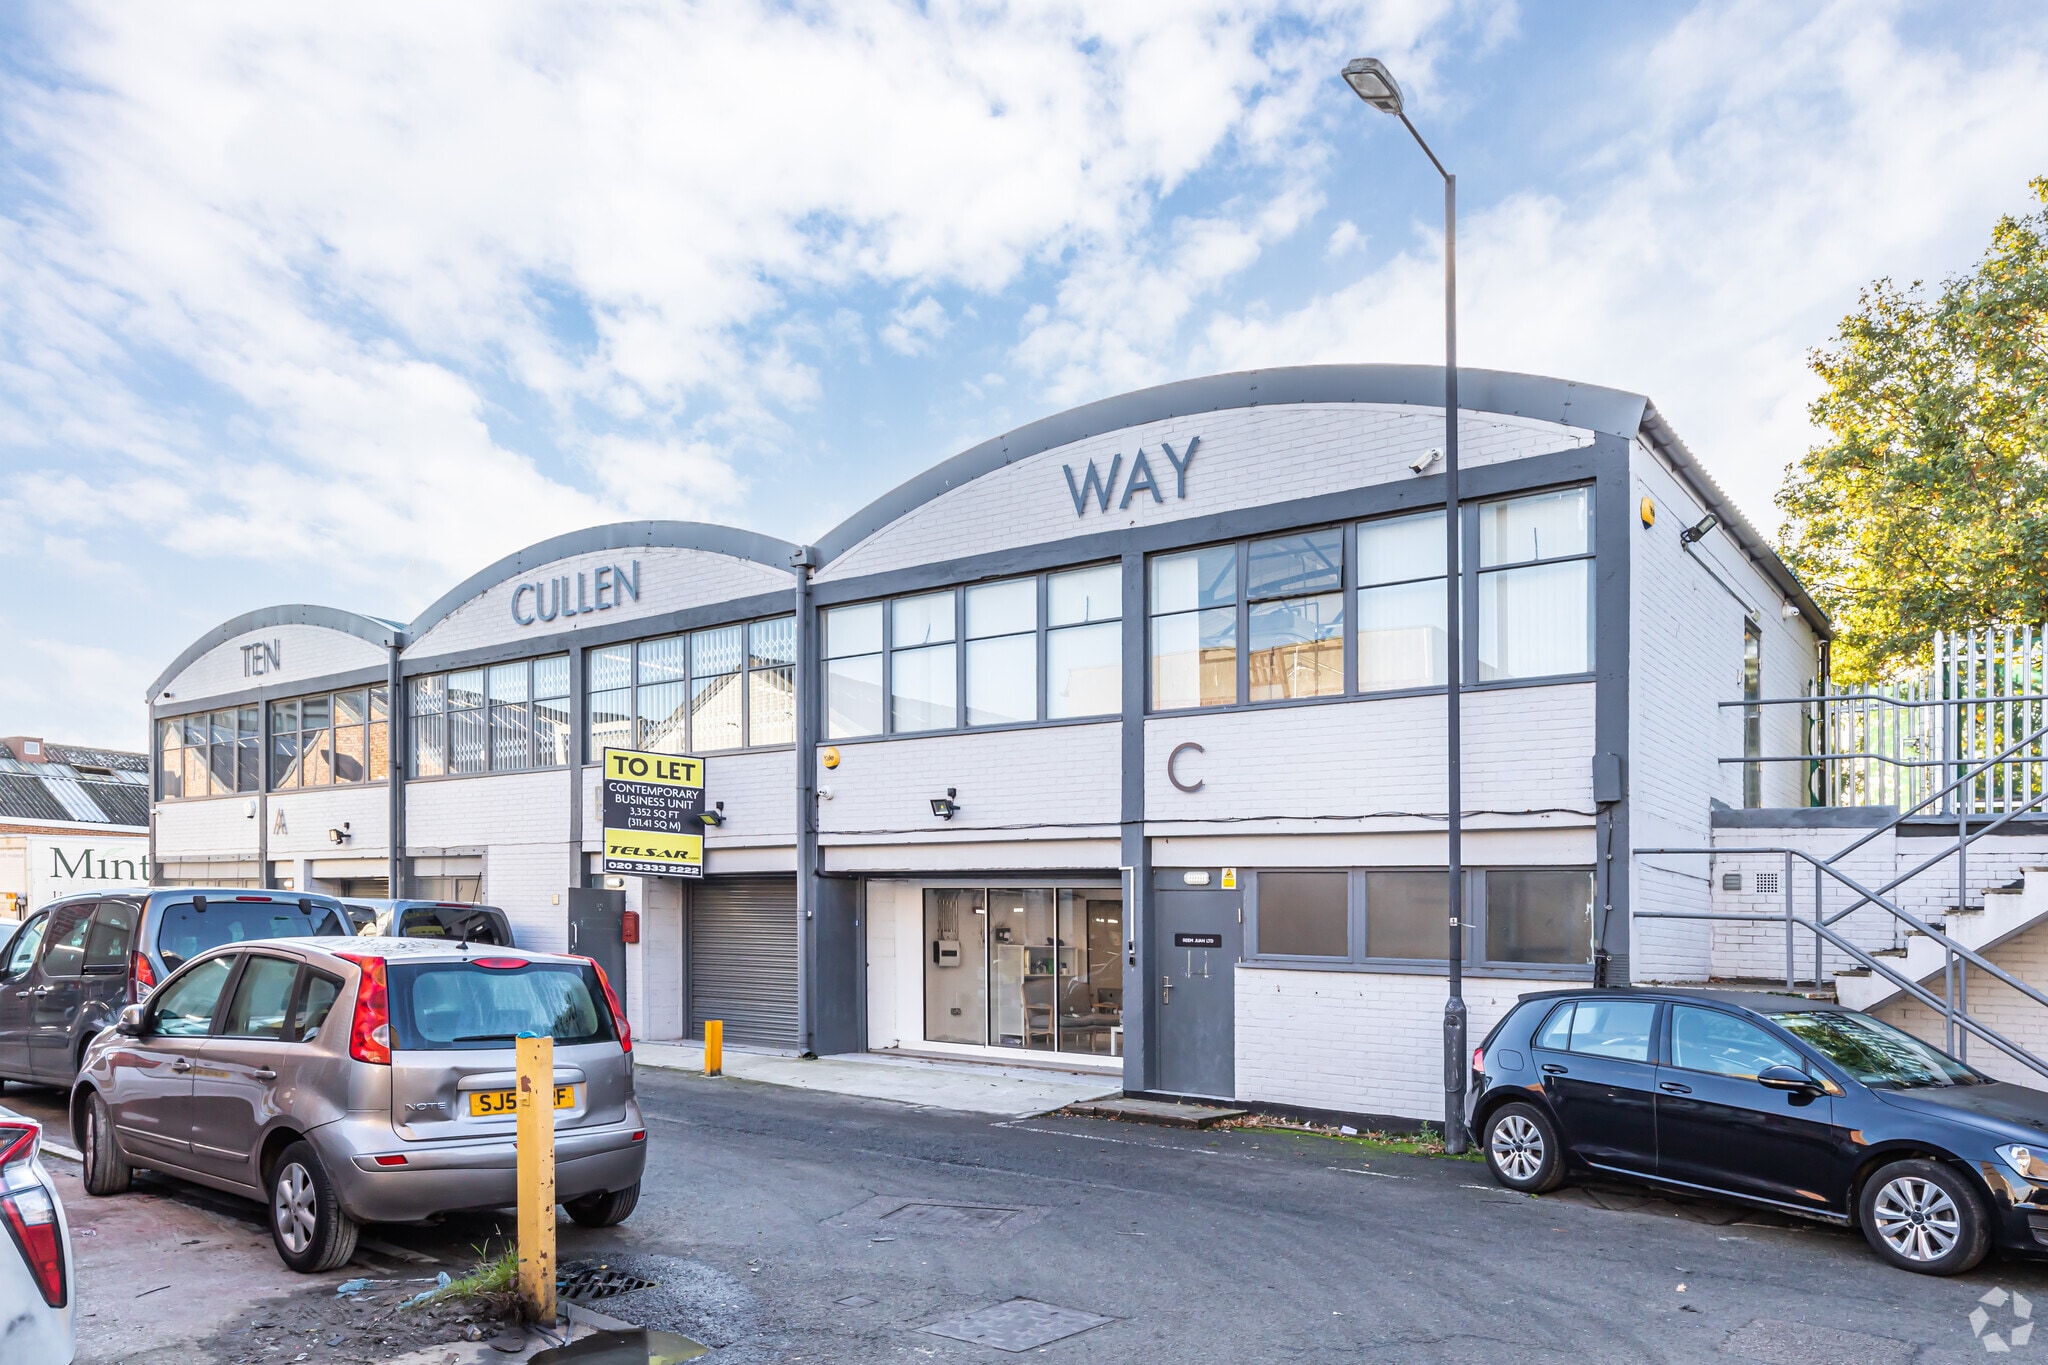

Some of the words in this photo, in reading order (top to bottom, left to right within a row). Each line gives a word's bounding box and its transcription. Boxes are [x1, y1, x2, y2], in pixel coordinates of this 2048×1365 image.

[1062, 436, 1200, 518] WAY
[511, 560, 639, 625] CULLEN
[240, 638, 280, 677] TEN
[613, 755, 649, 777] TO
[656, 760, 696, 781] LET
[1167, 742, 1205, 793] C
[608, 782, 699, 800] CONTEMPORARY
[615, 794, 665, 807] BUSINESS
[668, 799, 694, 809] UNIT
[273, 808, 288, 835] A
[629, 807, 651, 817] 3,352
[653, 809, 667, 819] SQ
[668, 810, 680, 819] FT
[628, 817, 652, 828] (311.41
[654, 820, 667, 830] SQ
[669, 821, 681, 832] M)
[609, 845, 688, 859] TELSAR
[49, 847, 150, 880] Mint
[608, 861, 632, 870] 020
[635, 863, 666, 872] 3333
[668, 865, 699, 874] 2222
[405, 1102, 446, 1111] NOTE
[480, 1092, 517, 1112] SJ5
